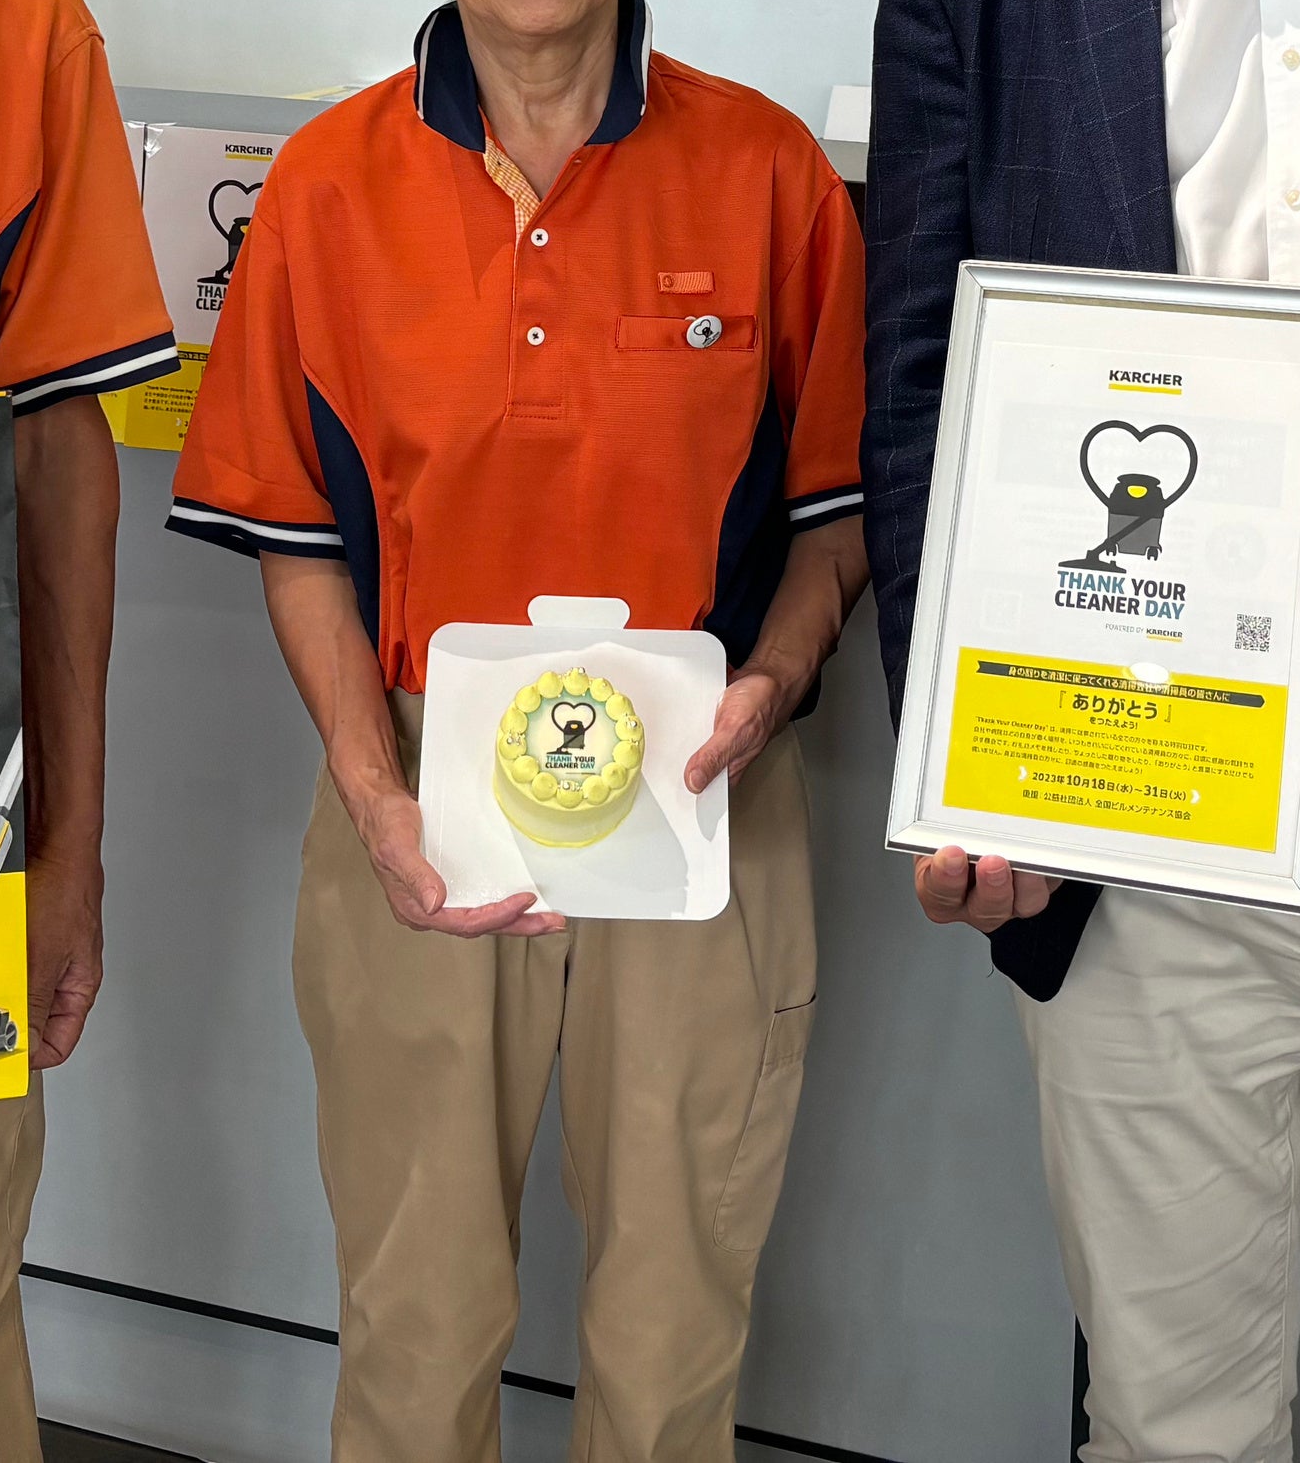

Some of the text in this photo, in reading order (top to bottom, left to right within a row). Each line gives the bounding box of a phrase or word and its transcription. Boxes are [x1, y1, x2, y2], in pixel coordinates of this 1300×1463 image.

[225, 144, 273, 155] KÄRCHER
[197, 285, 227, 298] THA
[1109, 370, 1182, 386] KÄRCHER
[1057, 570, 1186, 601] THANK YOUR
[1054, 590, 1185, 620] CLEANER DAY
[1105, 623, 1134, 633] POWERED
